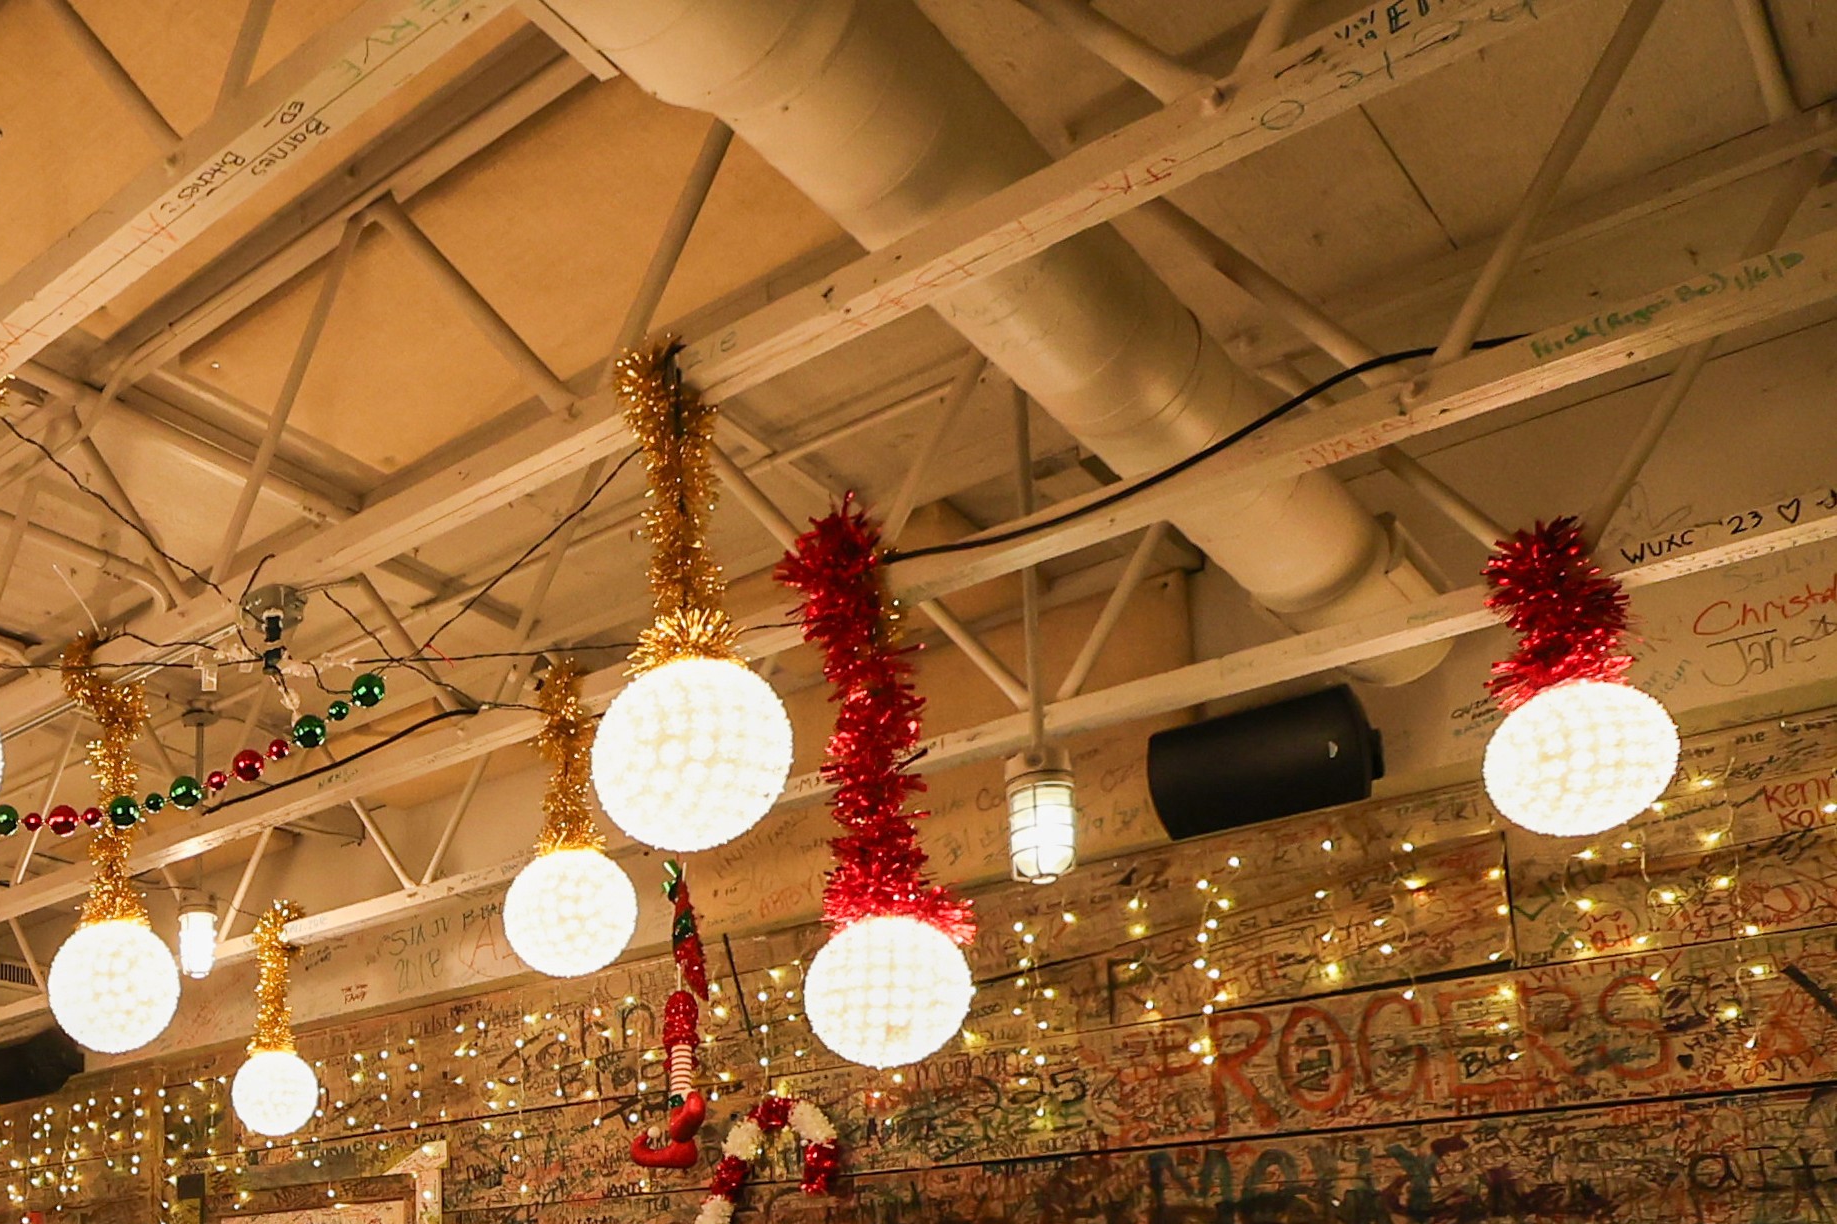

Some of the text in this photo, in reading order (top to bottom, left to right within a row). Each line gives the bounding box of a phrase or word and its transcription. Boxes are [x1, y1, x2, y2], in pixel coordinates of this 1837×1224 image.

[177, 150, 247, 203] Bitches
[251, 117, 331, 177] Barnes
[1209, 975, 1675, 1138] ROGERS
